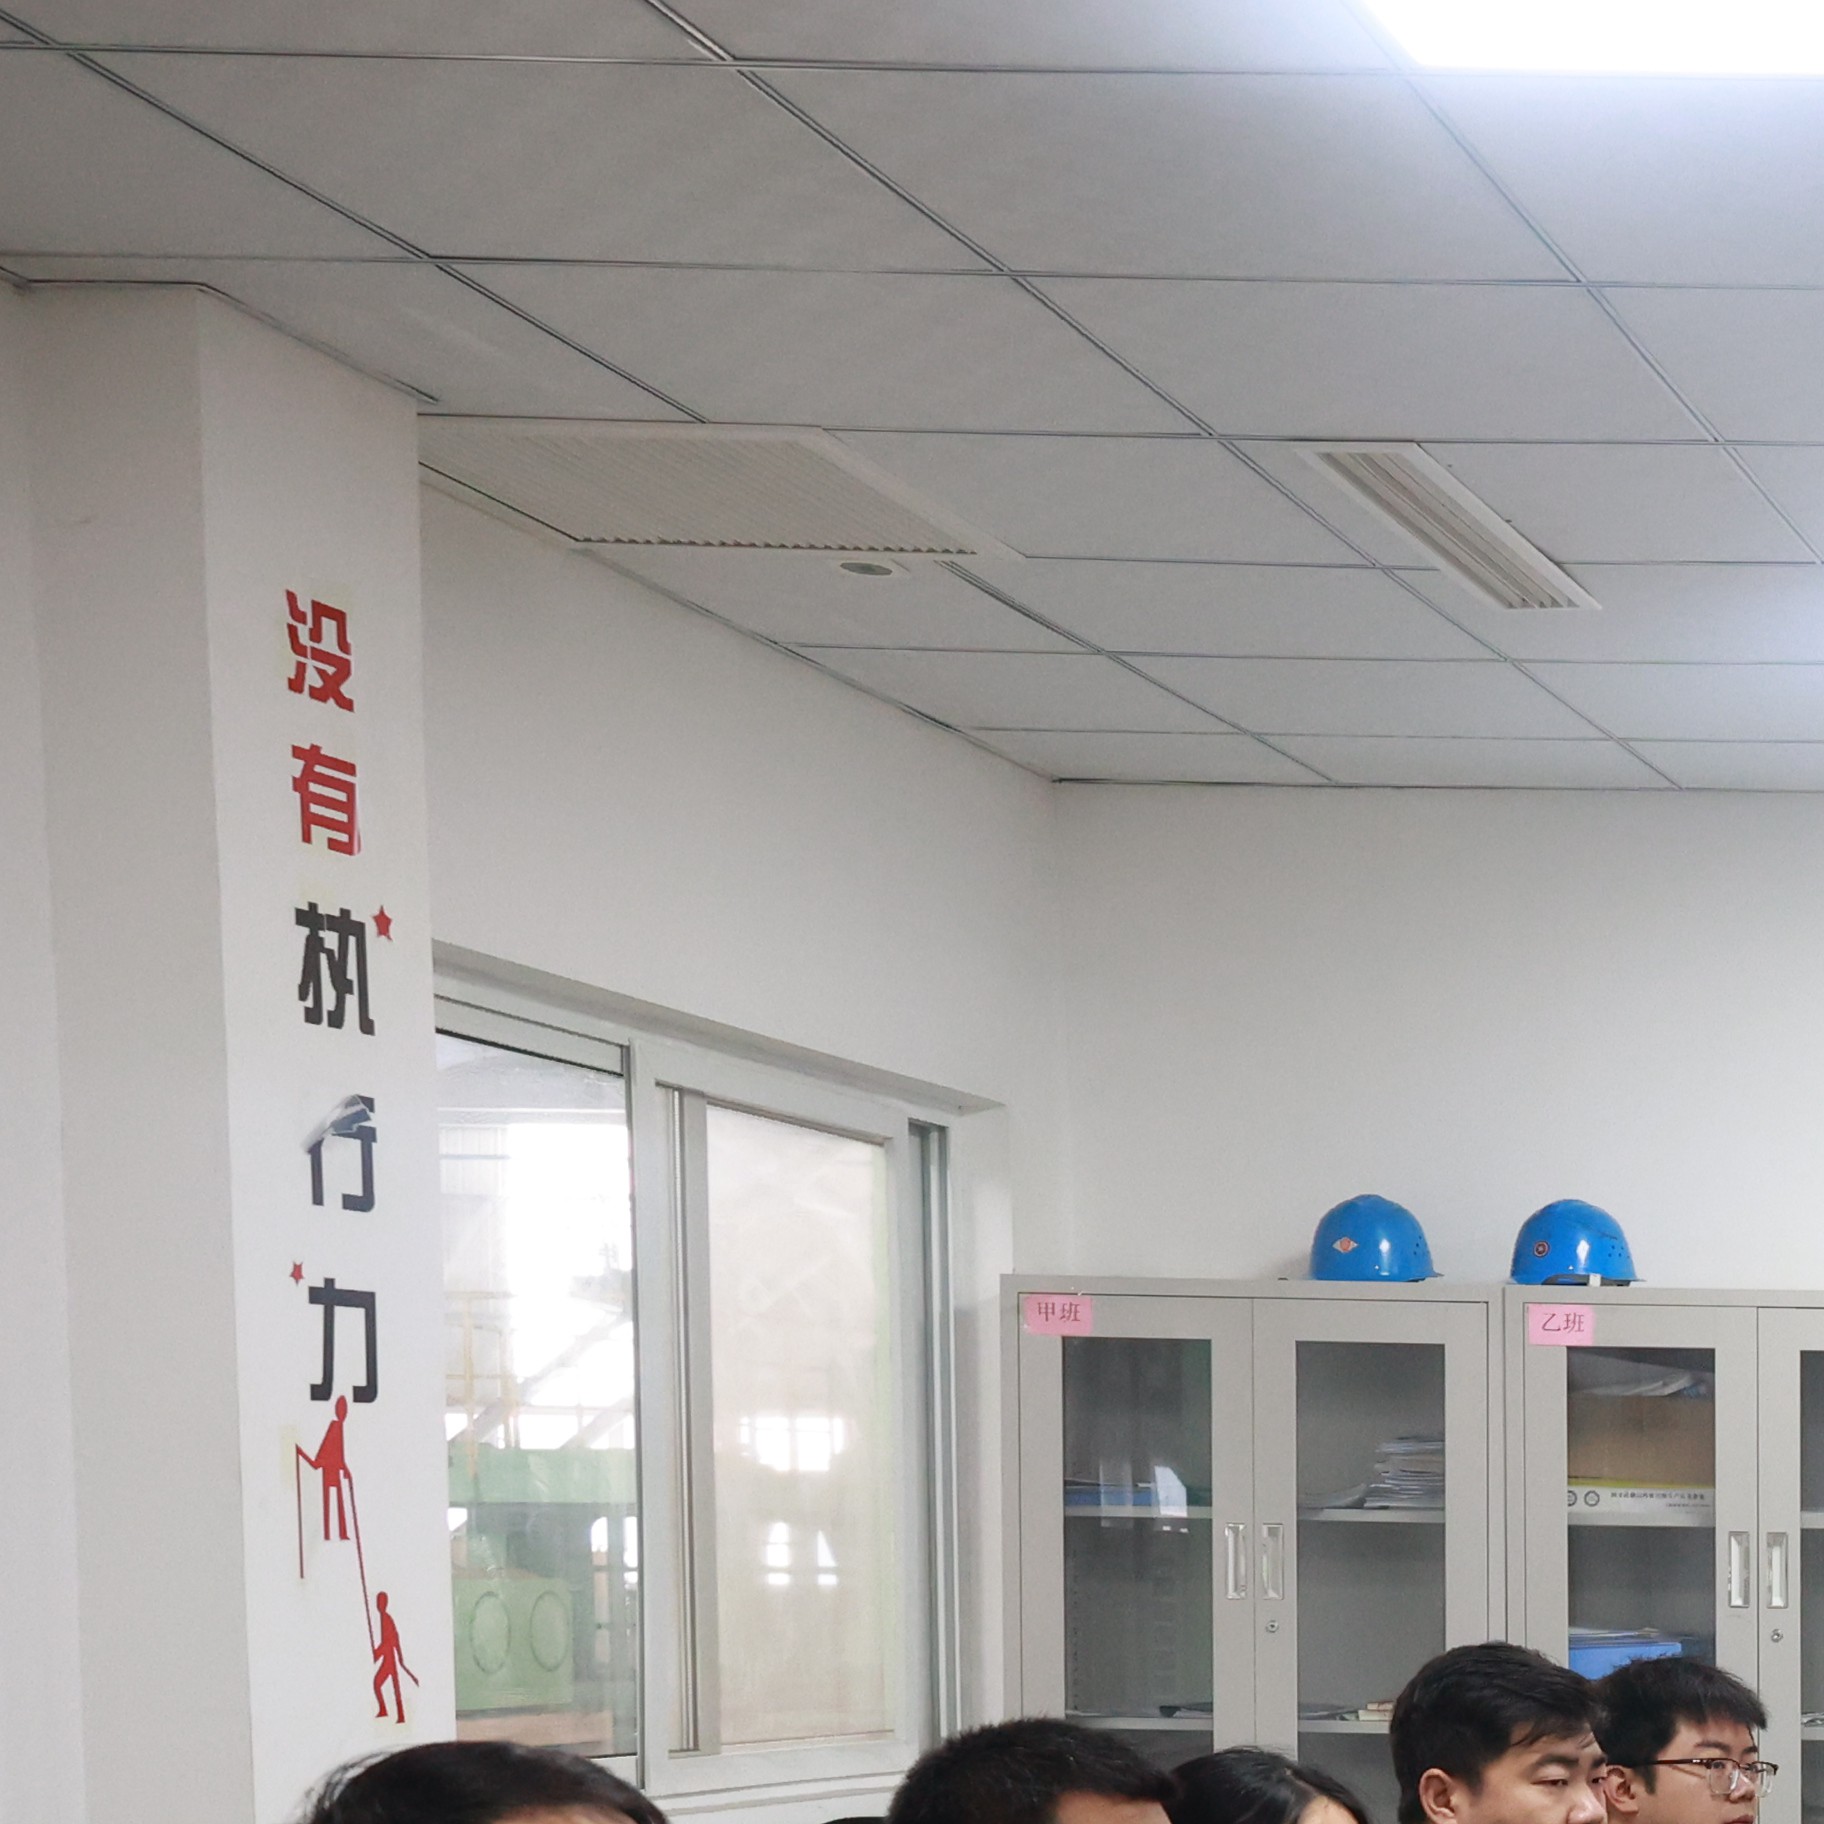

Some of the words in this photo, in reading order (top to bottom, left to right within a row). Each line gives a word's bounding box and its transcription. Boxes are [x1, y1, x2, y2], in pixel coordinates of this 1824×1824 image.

[284, 589, 378, 1403] 没有执行力
[1037, 1301, 1081, 1322] 甲班
[1541, 1312, 1585, 1334] 乙班
